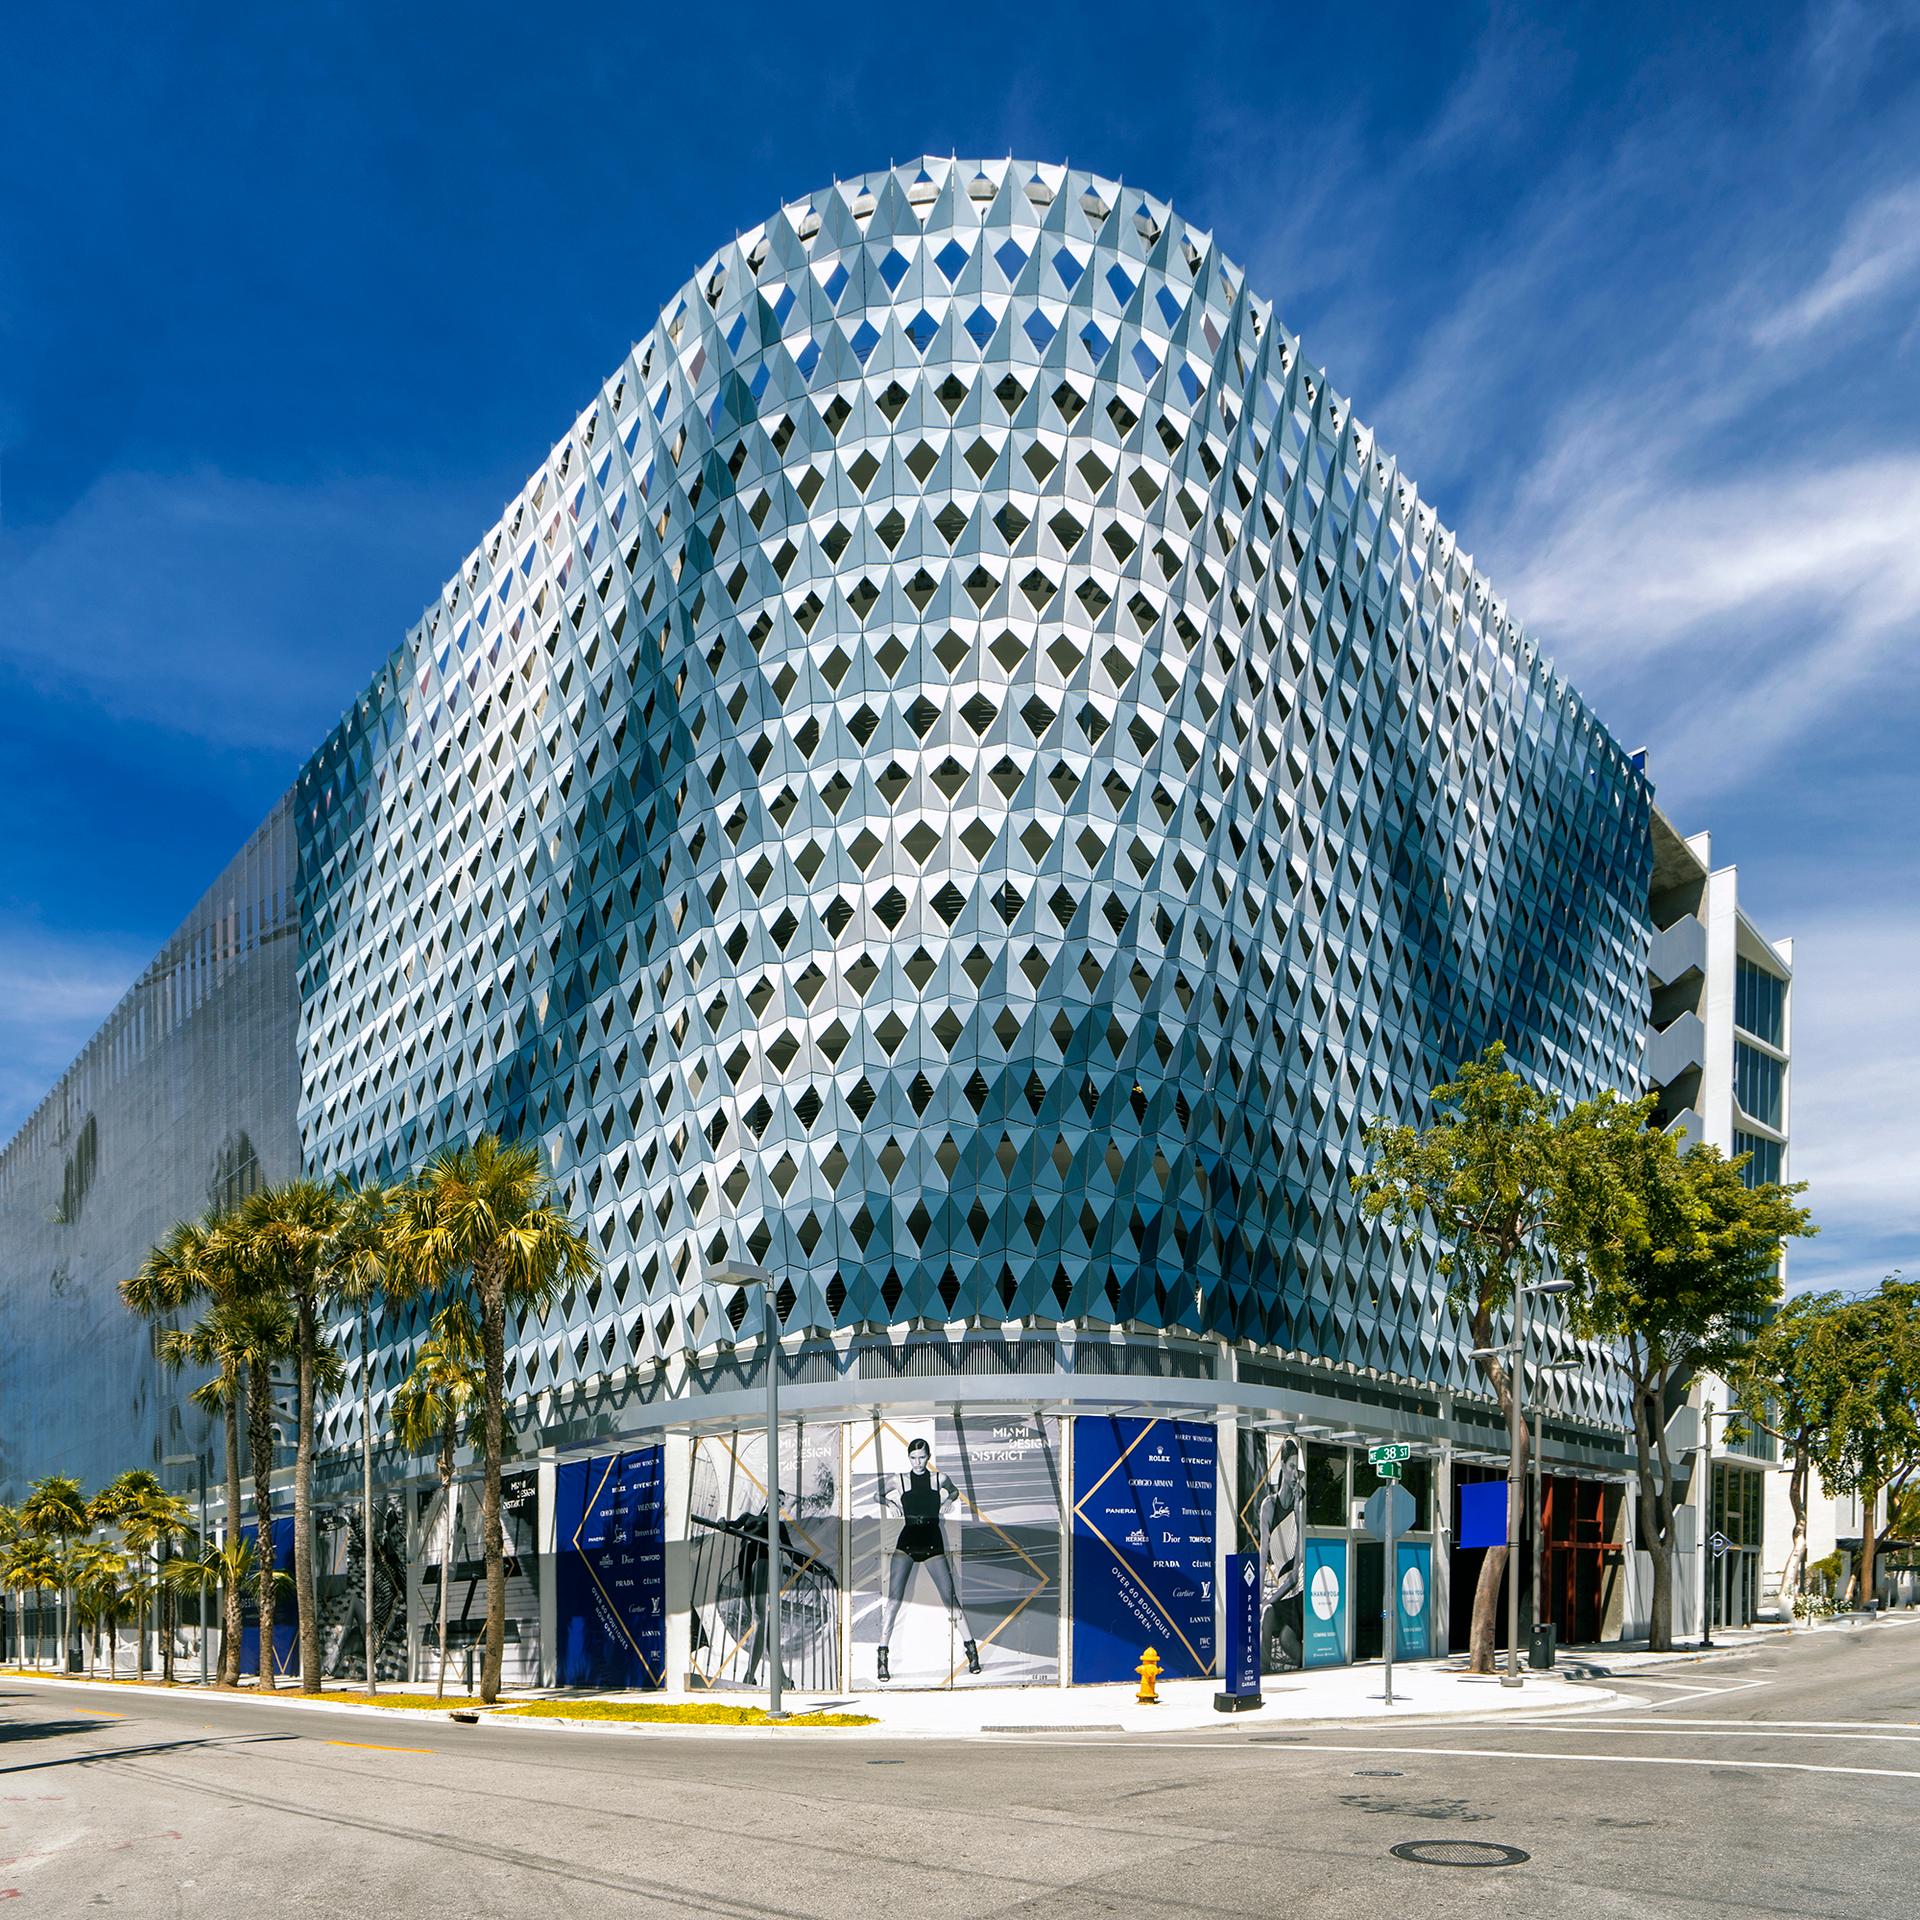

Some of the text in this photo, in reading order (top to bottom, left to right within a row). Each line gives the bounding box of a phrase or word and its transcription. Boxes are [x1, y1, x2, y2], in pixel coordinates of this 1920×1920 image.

[993, 1427, 1029, 1438] MIAMI
[1009, 1439, 1052, 1449] DESIGN
[971, 1451, 1025, 1461] DISTRICT
[1148, 1455, 1171, 1463] ROLEX
[1383, 1447, 1397, 1460] 38
[1400, 1447, 1408, 1457] ST
[1181, 1457, 1212, 1465] GIVENCHY
[1163, 1532, 1180, 1543] Dior
[1192, 1560, 1212, 1568] CÉLINE
[1172, 1587, 1195, 1598] Cartier
[1111, 1567, 1171, 1639] OVER 60 BOUTIQUES
[1118, 1590, 1152, 1632] NOW OPEN.
